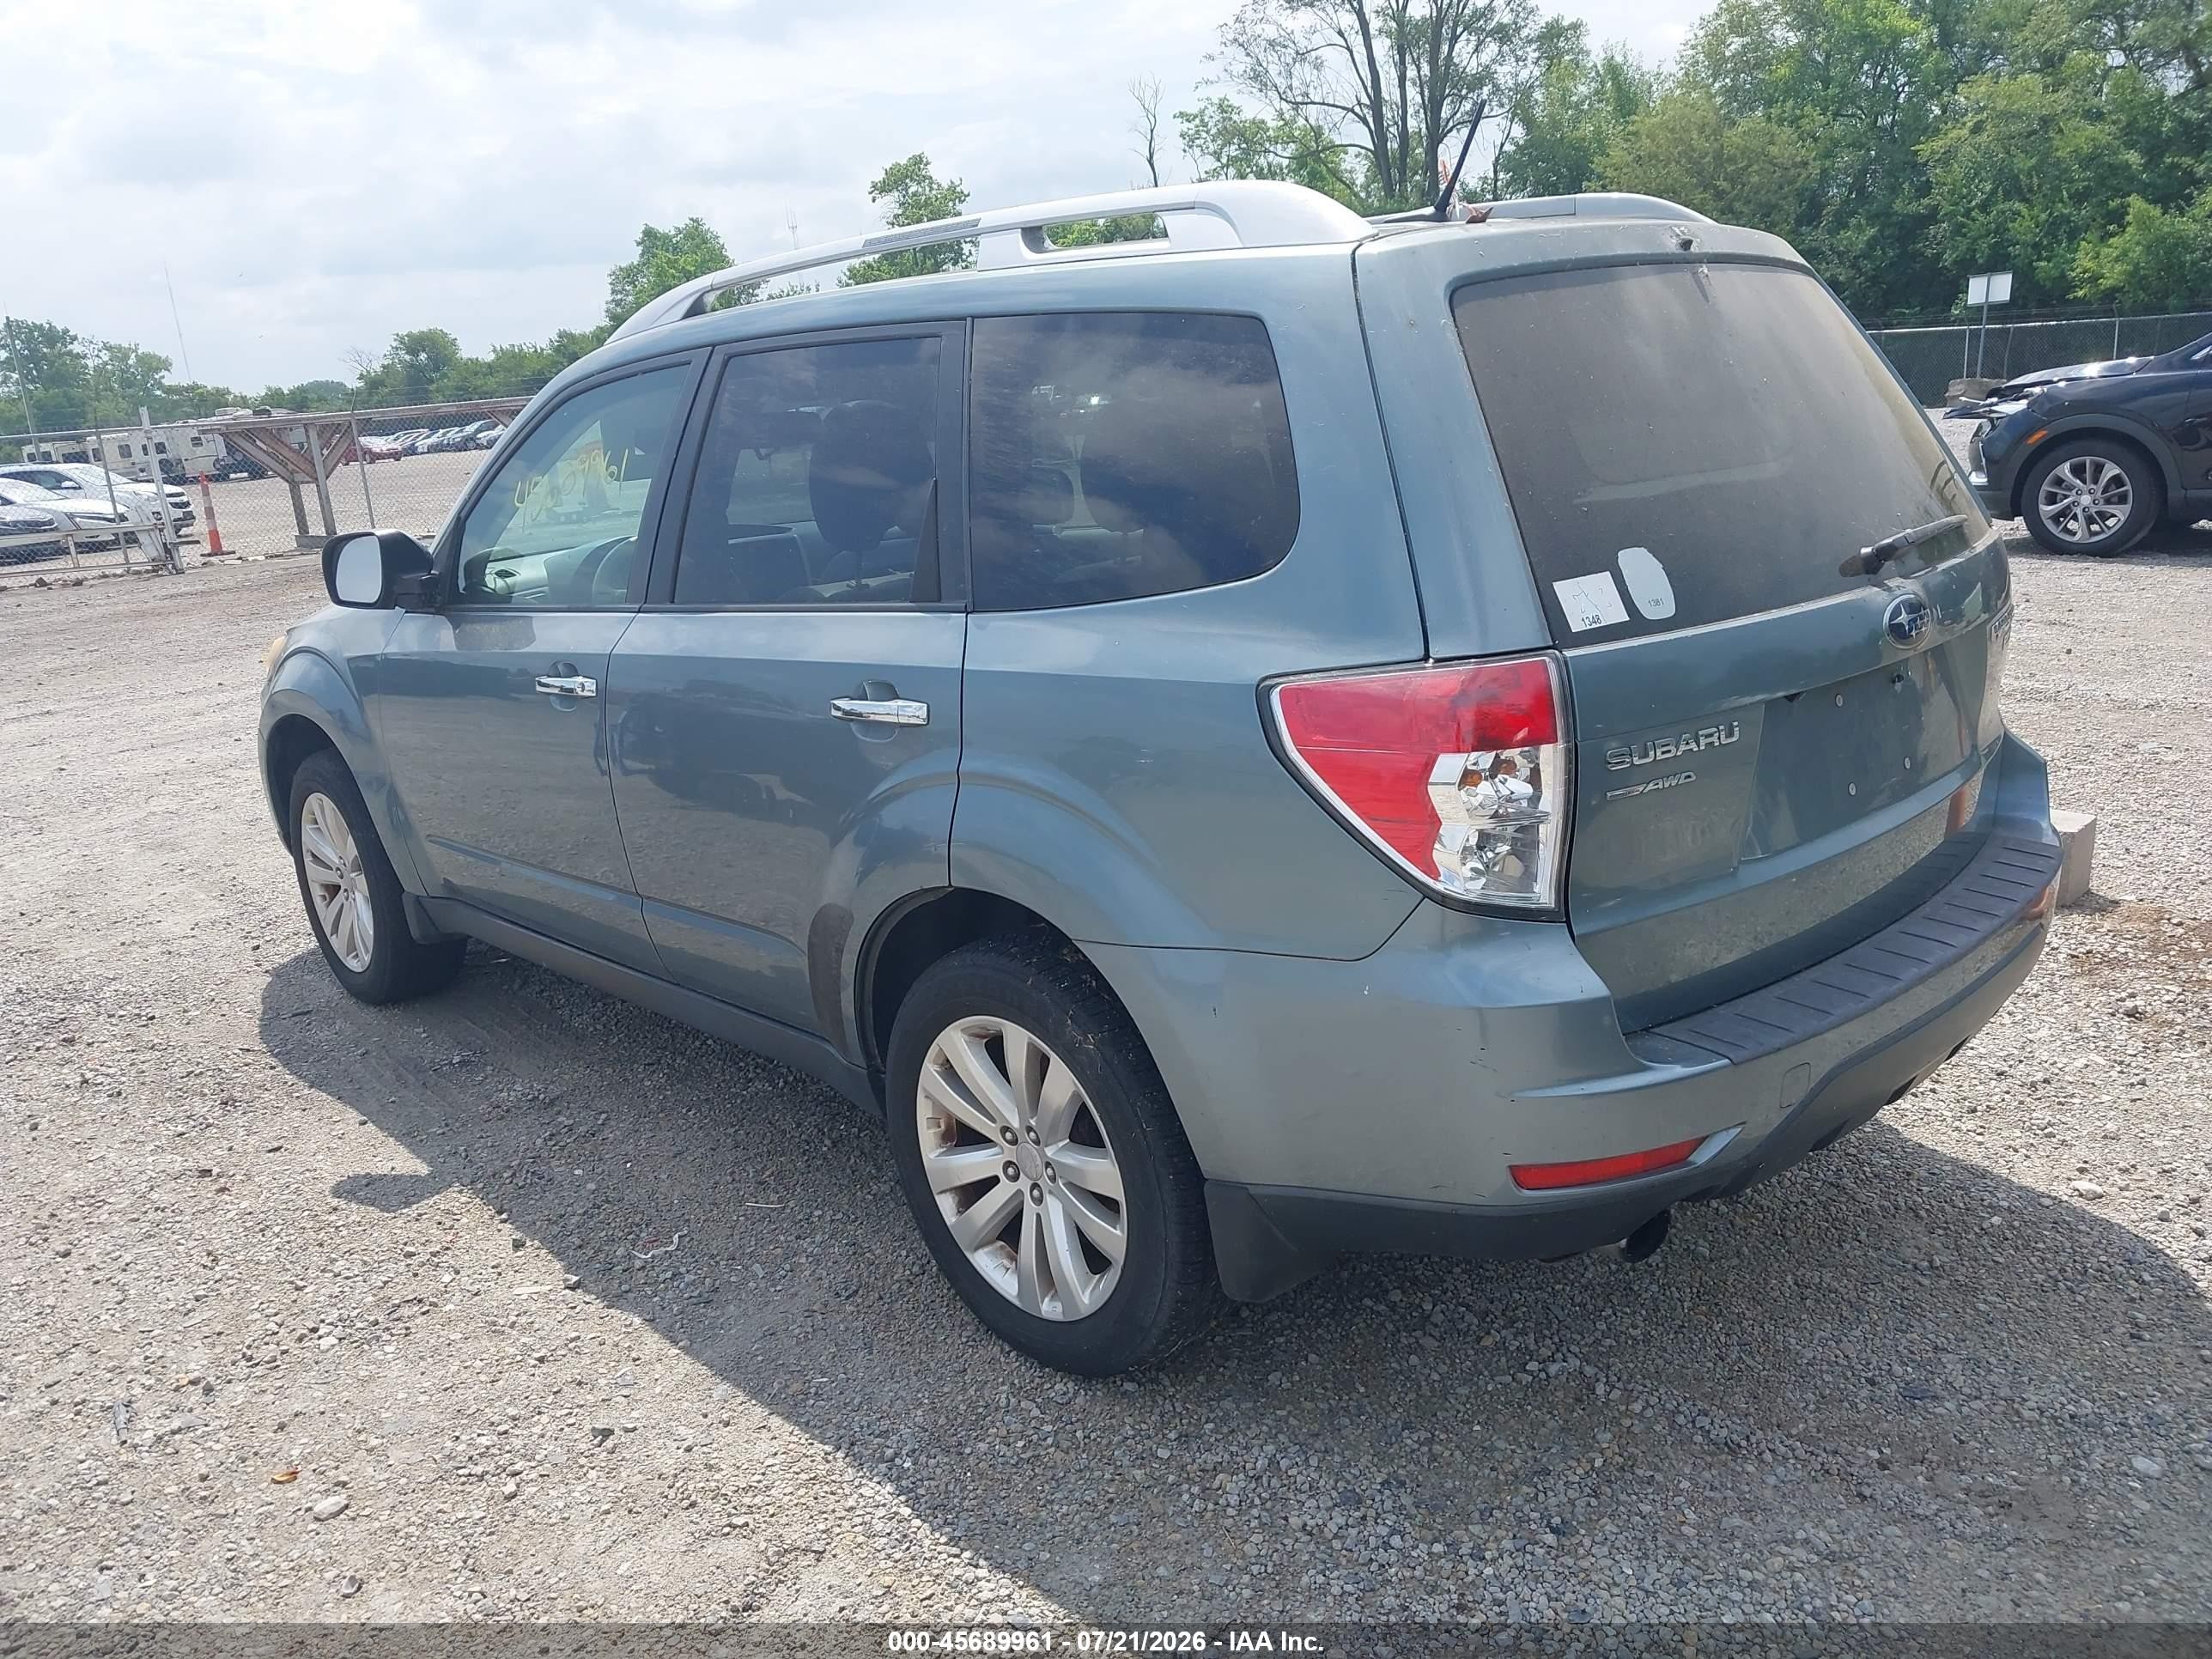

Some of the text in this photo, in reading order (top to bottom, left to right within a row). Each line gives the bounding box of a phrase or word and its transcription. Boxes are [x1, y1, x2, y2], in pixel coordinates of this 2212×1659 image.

[1581, 614, 1602, 628] 1348
[1607, 721, 1740, 771] SUBARU
[1643, 771, 1697, 793] AWD
